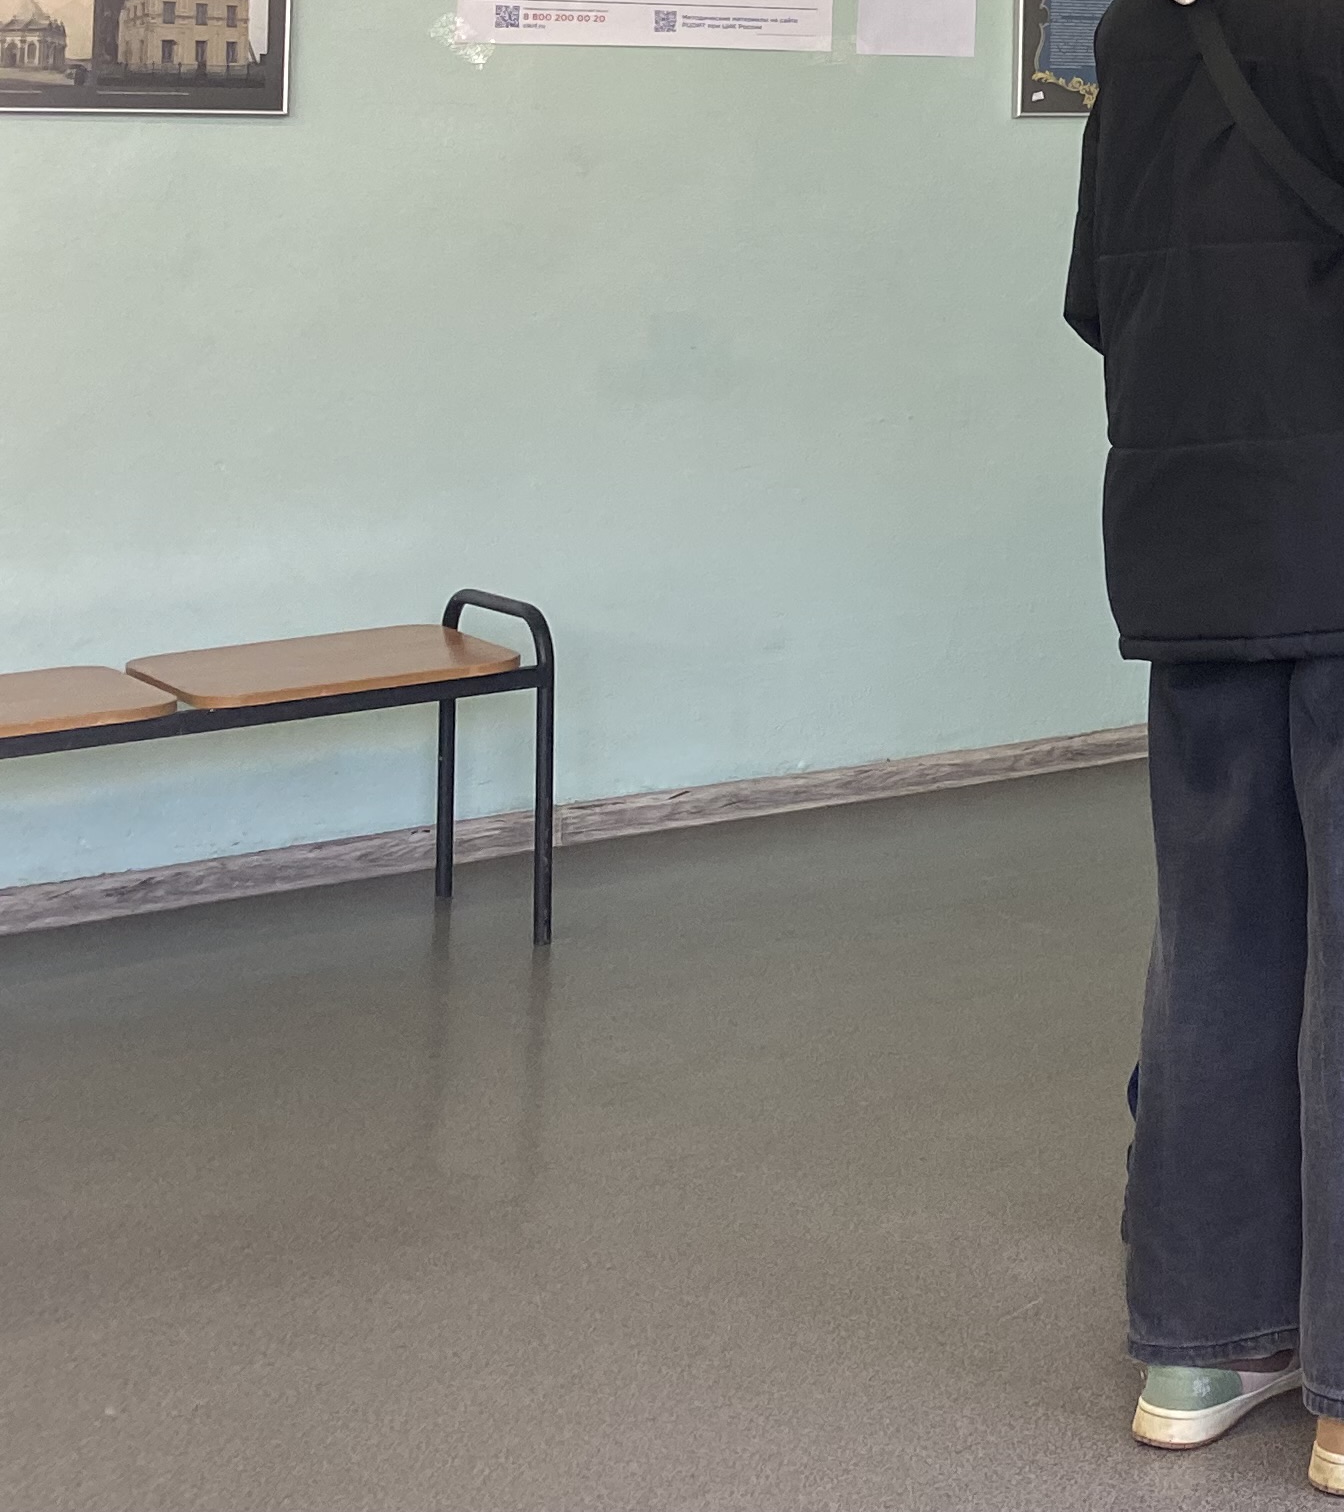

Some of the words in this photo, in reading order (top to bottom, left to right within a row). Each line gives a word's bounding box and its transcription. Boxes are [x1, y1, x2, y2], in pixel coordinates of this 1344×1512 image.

[523, 13, 529, 21] 8
[532, 13, 552, 21] 800
[554, 14, 574, 22] 200
[577, 14, 590, 23] 00
[593, 15, 606, 23] 20
